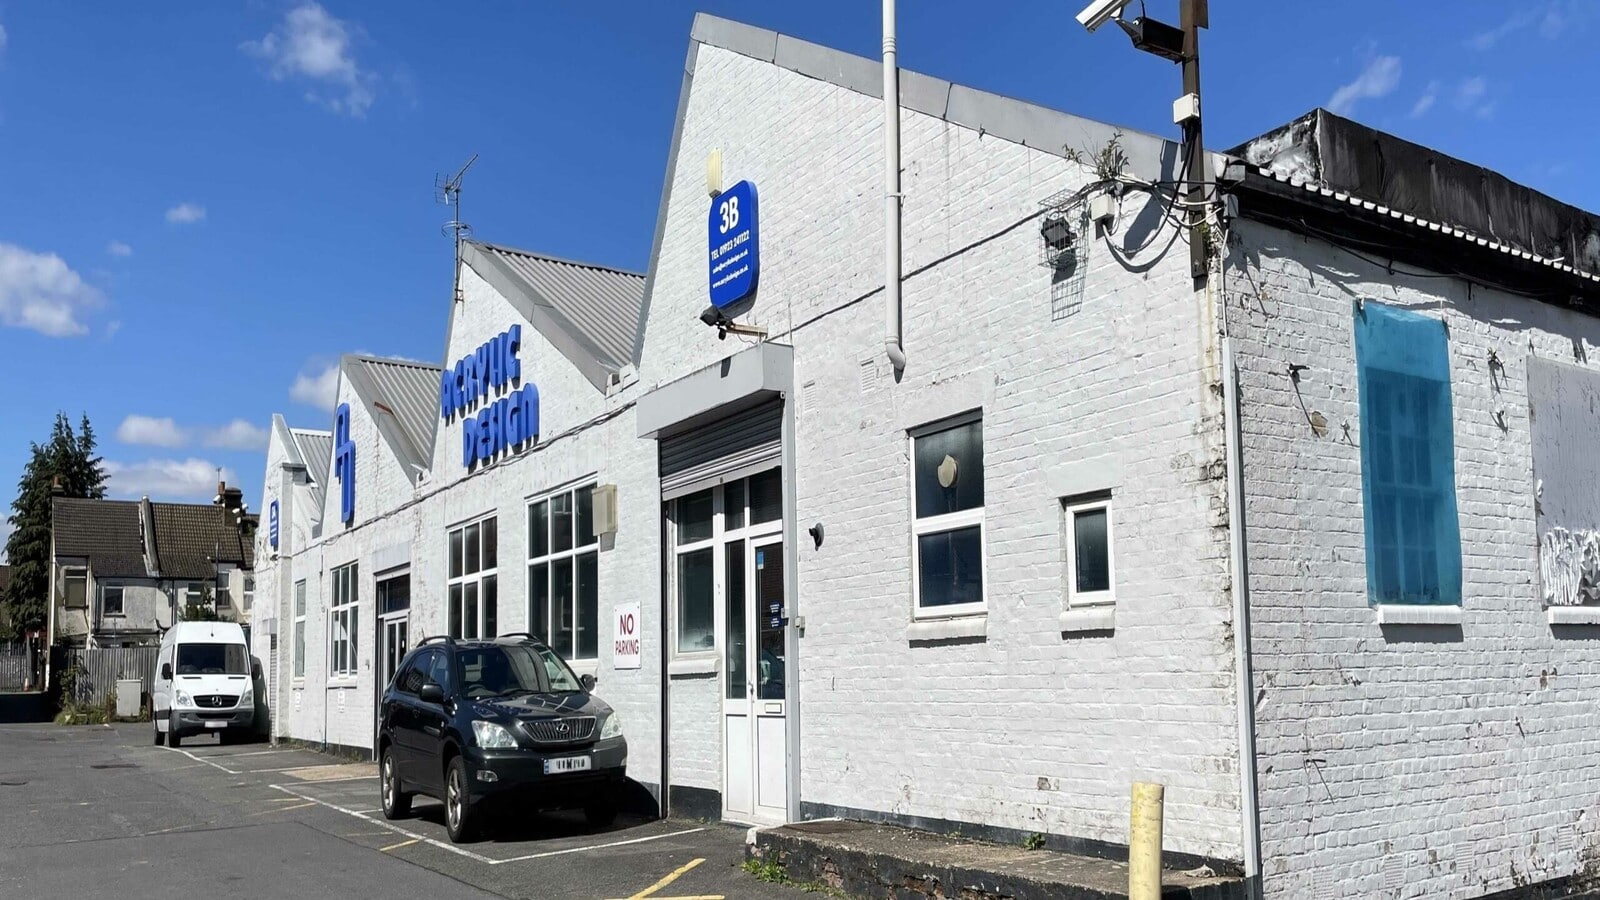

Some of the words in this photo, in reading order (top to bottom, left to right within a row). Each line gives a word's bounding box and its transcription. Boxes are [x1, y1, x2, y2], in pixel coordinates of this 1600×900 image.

[720, 196, 739, 234] 3B
[441, 324, 521, 418] ACRYLIC
[463, 383, 539, 468] DESIGN
[620, 613, 634, 635] NO
[615, 639, 639, 655] PARKING
